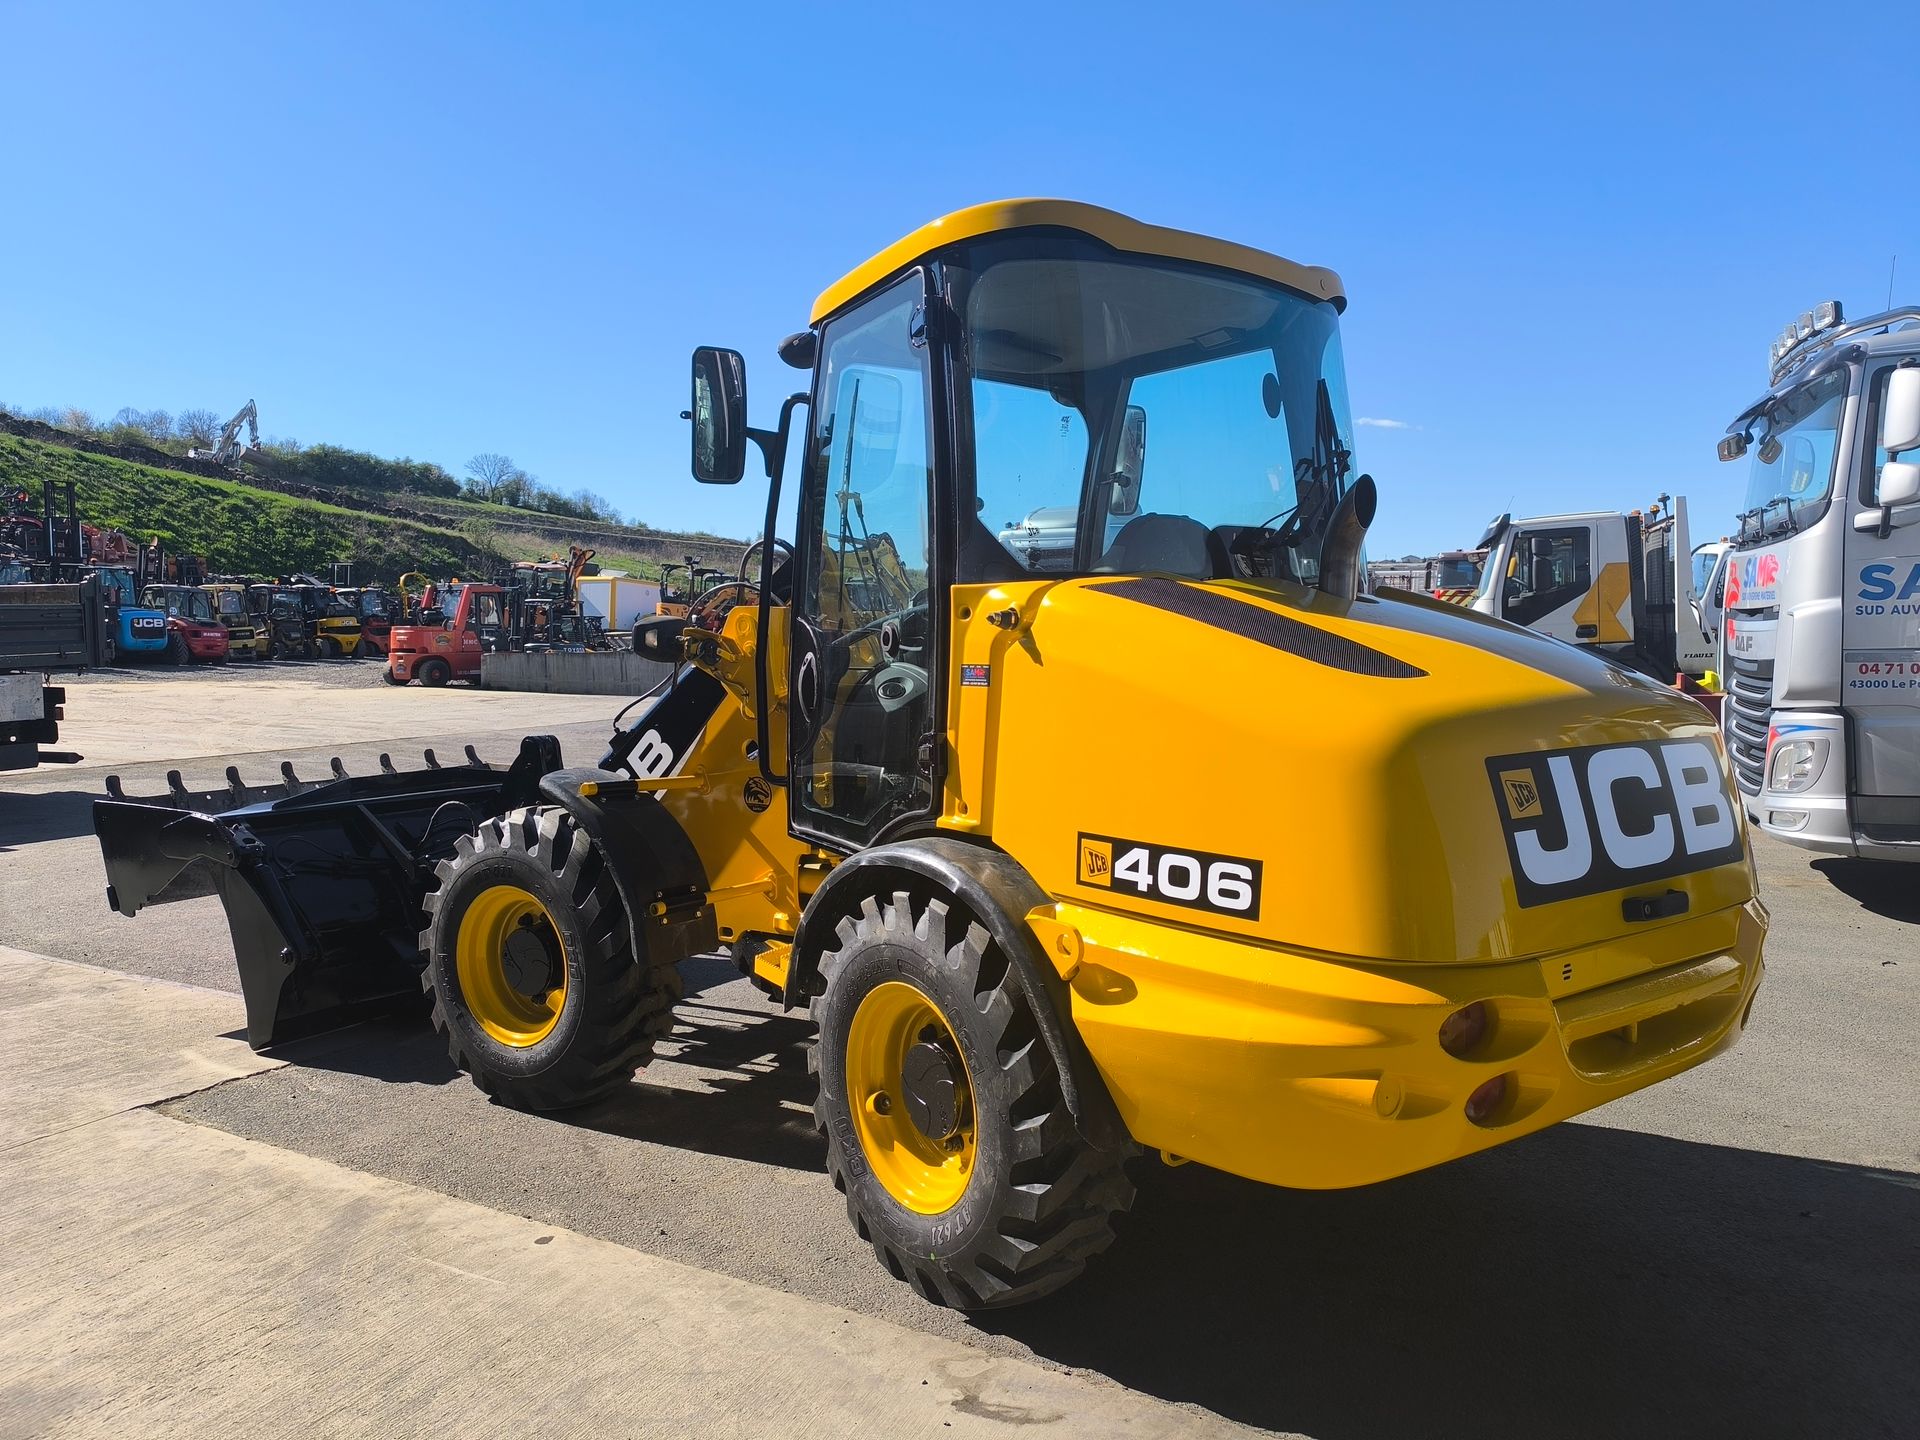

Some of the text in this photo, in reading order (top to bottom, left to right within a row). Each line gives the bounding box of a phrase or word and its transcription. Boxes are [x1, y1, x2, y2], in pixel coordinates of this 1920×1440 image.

[1855, 605, 1885, 616] SUD
[134, 619, 164, 628] JCB
[1735, 635, 1753, 652] DAF
[1858, 663, 1881, 675] 04
[1884, 663, 1904, 675] 71
[1849, 679, 1888, 689] 43000
[1891, 680, 1906, 689] Le
[1512, 781, 1536, 808] JCB
[1514, 742, 1735, 885] JCB
[1087, 847, 1253, 911] JCB 406
